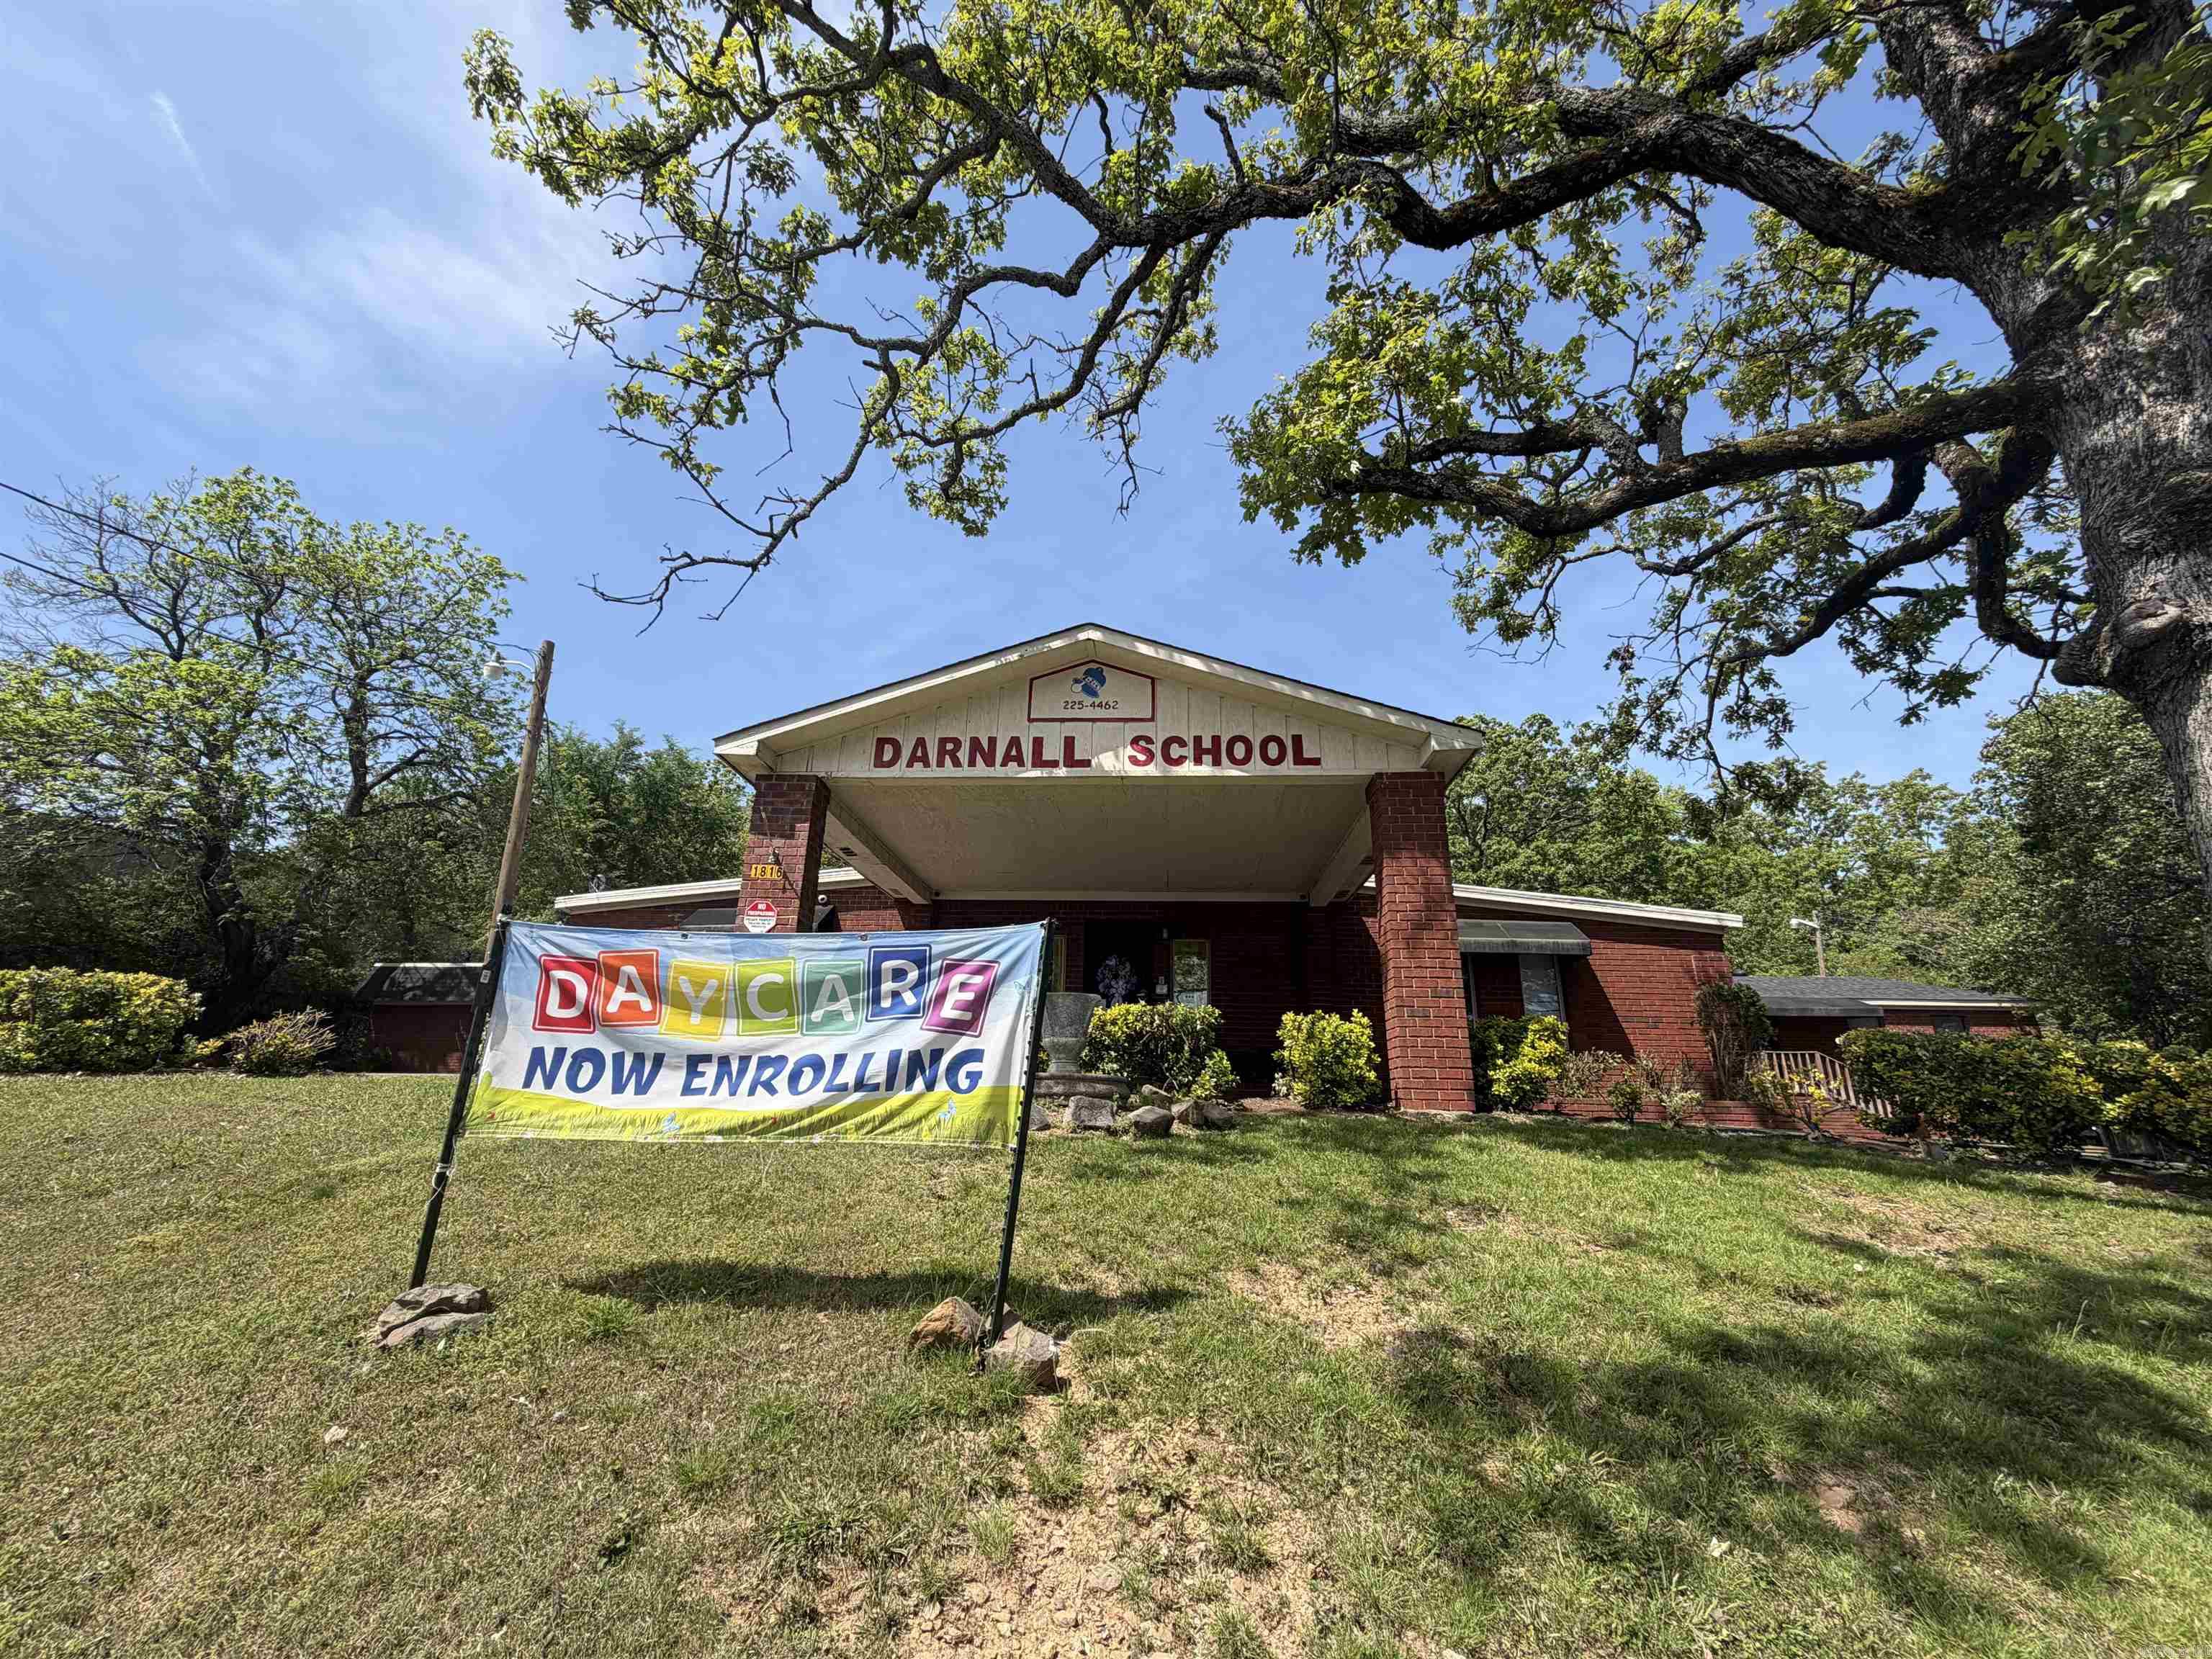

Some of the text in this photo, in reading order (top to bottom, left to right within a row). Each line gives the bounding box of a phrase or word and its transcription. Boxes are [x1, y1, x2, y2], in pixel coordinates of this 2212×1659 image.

[1063, 700, 1118, 710] 225-4462
[873, 734, 1321, 768] DARNALL SCHOOL
[753, 866, 783, 877] 1816
[545, 959, 984, 1025] DAYCARE
[521, 1046, 985, 1097] NOW ENROLLING
